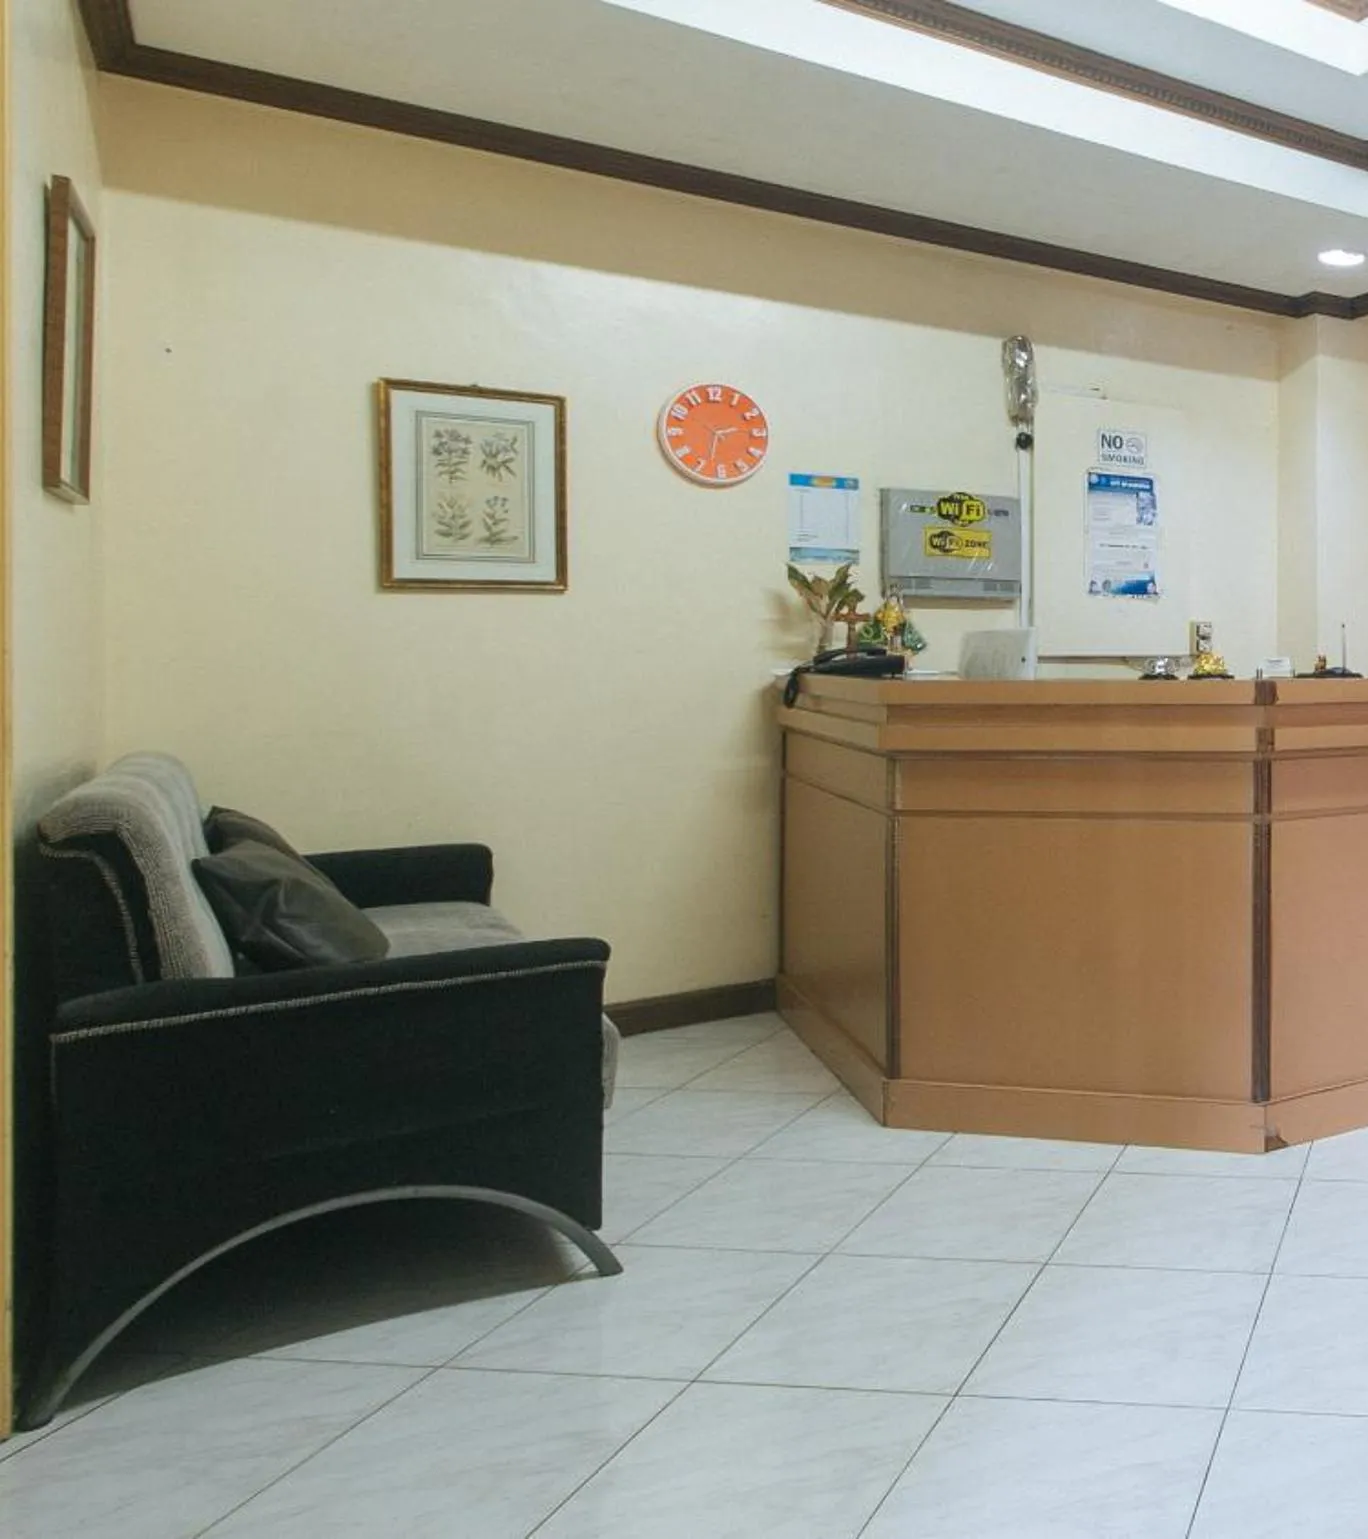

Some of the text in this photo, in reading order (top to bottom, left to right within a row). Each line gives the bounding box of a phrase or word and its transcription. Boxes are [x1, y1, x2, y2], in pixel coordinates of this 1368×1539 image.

[685, 390, 701, 406] 11
[705, 387, 722, 402] 12
[730, 393, 740, 406] 1
[671, 404, 688, 420] 10
[743, 408, 760, 420] 2
[667, 427, 683, 437] 9
[751, 428, 766, 437] 3
[1101, 433, 1123, 449] NO
[676, 445, 690, 457] 8
[747, 447, 764, 458] 4
[693, 458, 706, 472] 7
[1101, 453, 1144, 465] SMOKING
[716, 464, 726, 479] 6
[735, 459, 750, 473] 5
